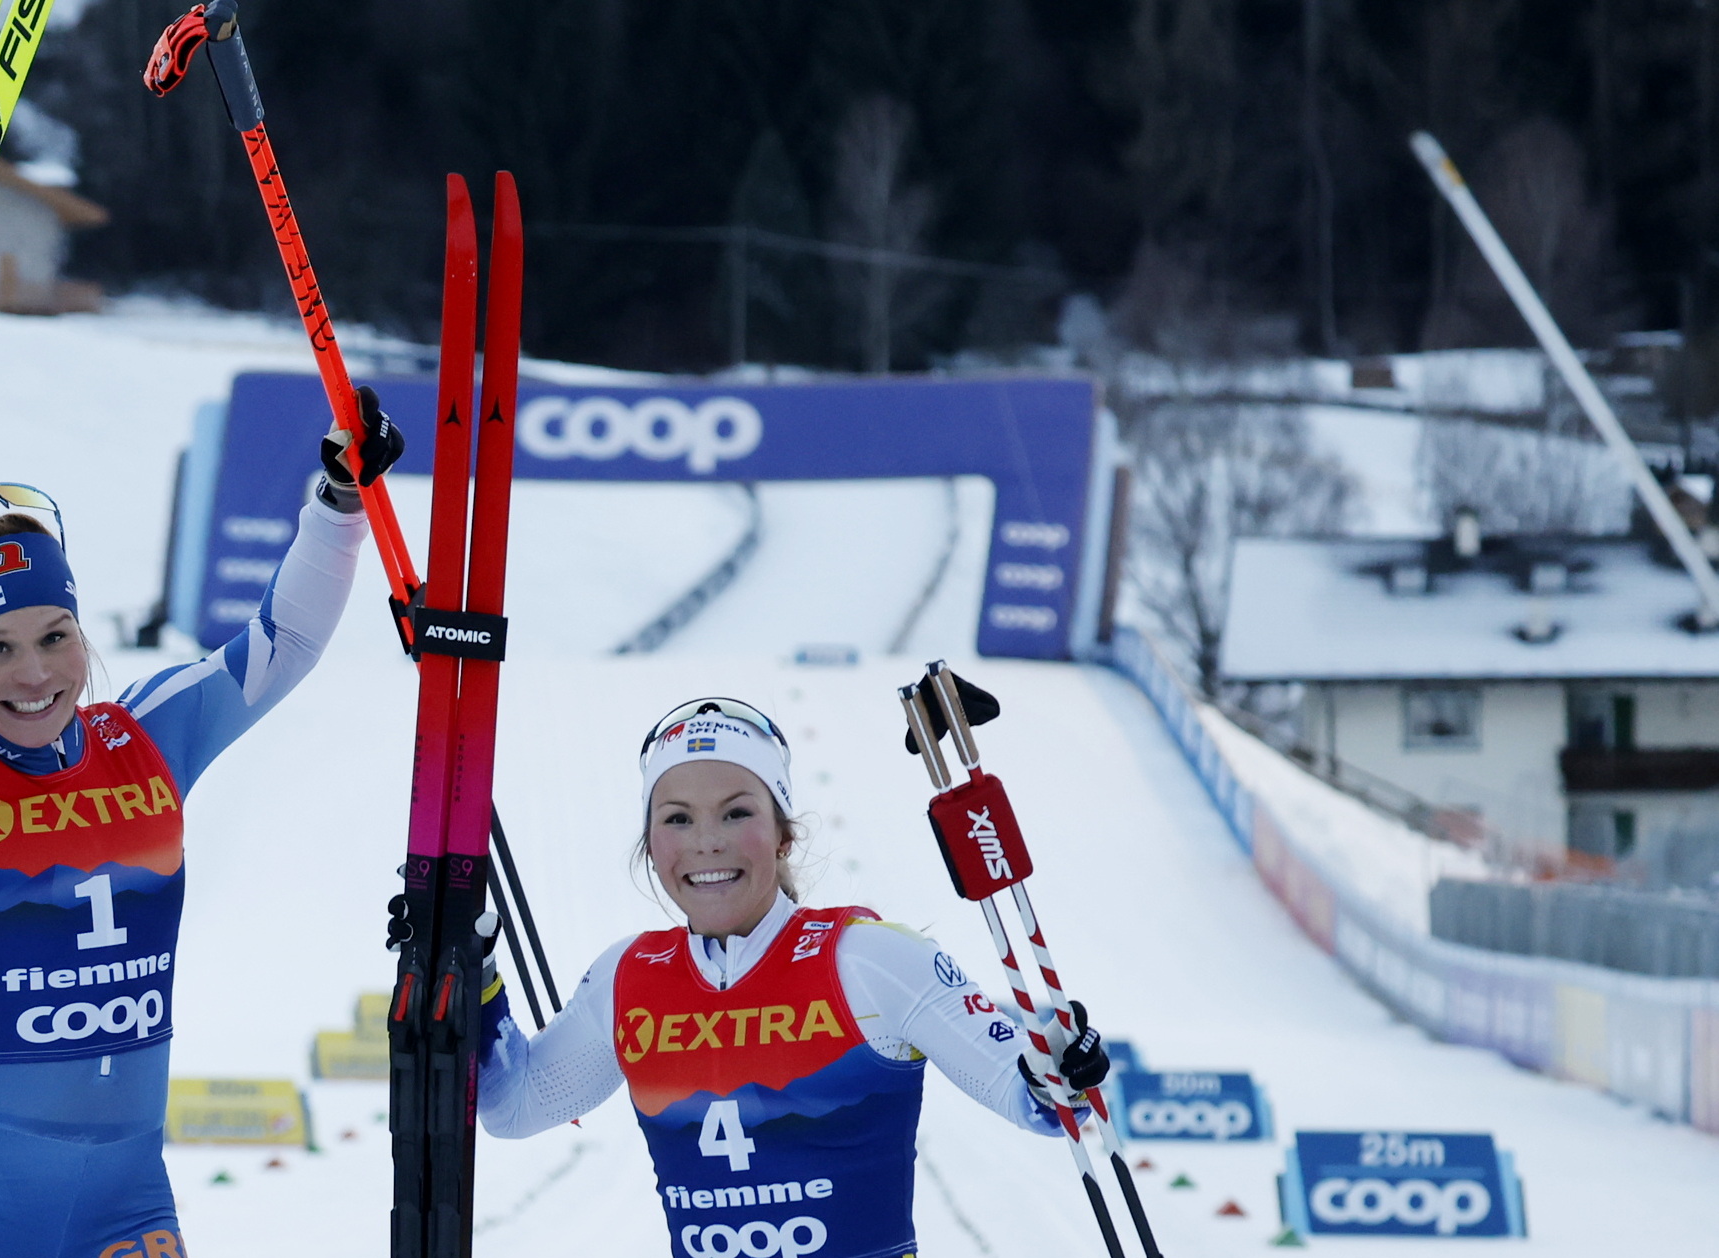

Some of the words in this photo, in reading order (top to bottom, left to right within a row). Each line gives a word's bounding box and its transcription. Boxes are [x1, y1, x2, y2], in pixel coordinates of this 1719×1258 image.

[517, 399, 764, 473] coop
[424, 624, 492, 645] ATOMIC
[689, 721, 751, 739] SVENSKA
[18, 775, 177, 834] EXTRA
[448, 857, 473, 877] S9
[74, 873, 128, 950] 1
[1, 952, 170, 992] fiemme
[16, 989, 163, 1043] coop
[657, 1000, 844, 1053] EXTRA
[466, 1051, 477, 1127] ATOMIC
[698, 1101, 756, 1172] 4
[1130, 1100, 1253, 1139] coop
[1359, 1135, 1446, 1167] 25m
[666, 1177, 834, 1209] fiemme
[1309, 1178, 1492, 1236] coop
